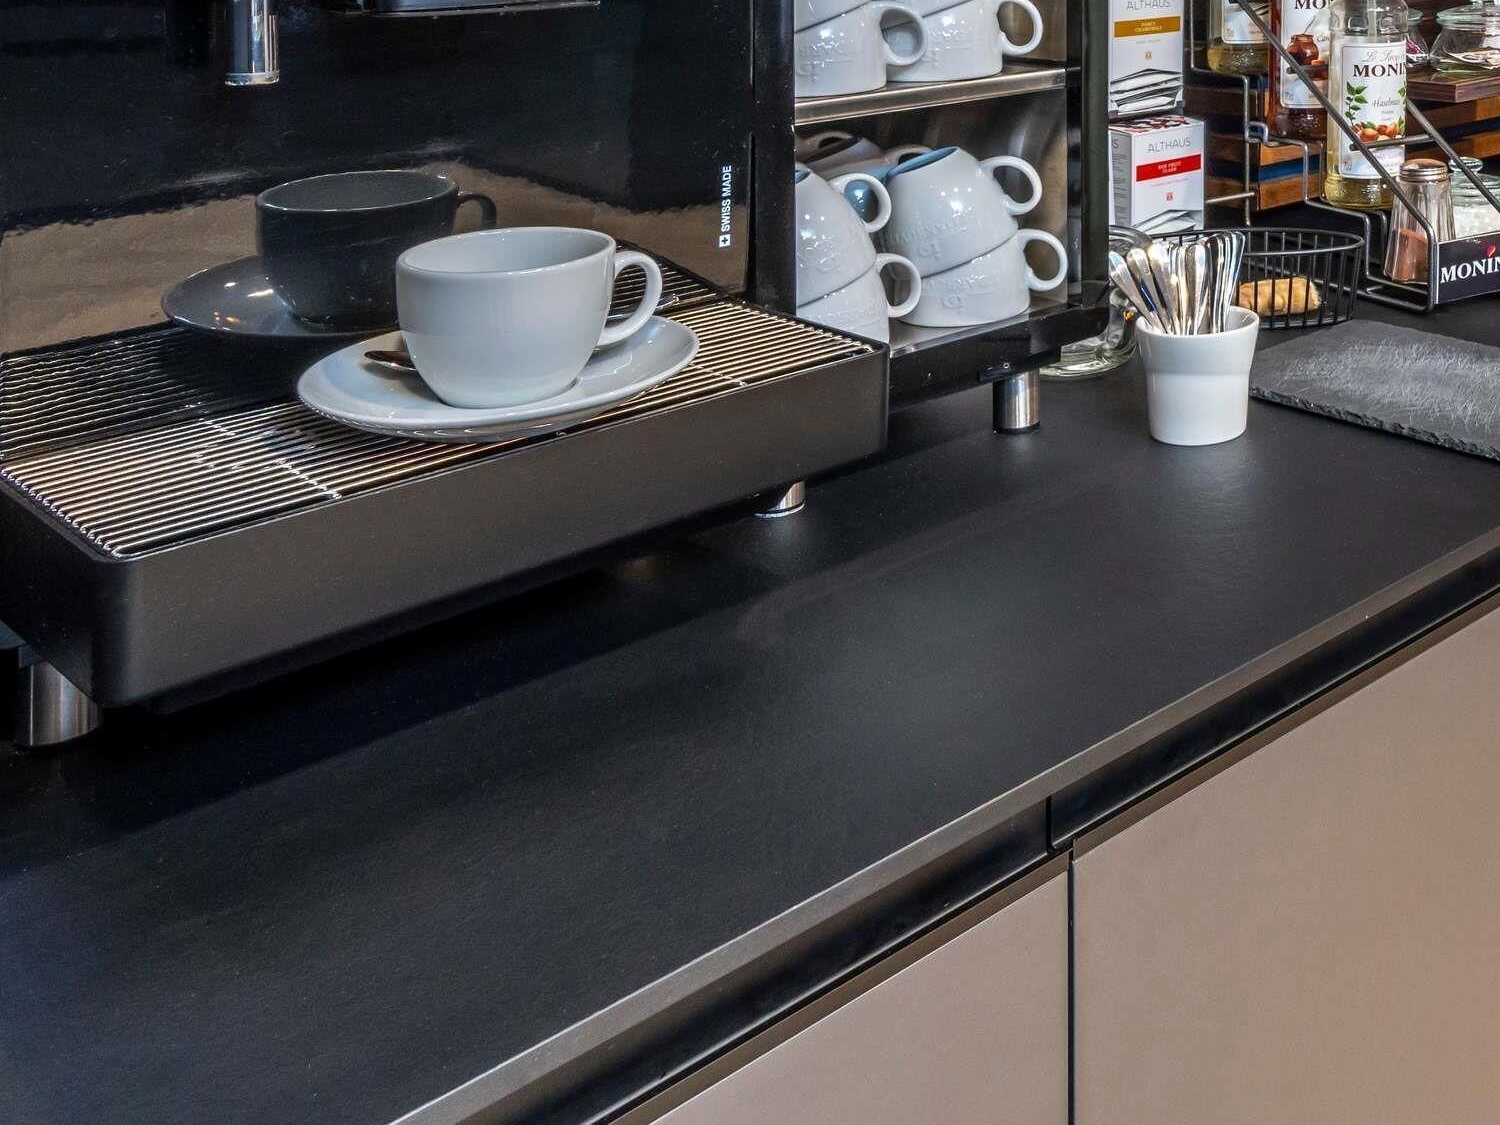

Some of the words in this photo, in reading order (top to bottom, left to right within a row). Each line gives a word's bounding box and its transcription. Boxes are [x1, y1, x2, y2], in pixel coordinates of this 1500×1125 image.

[1147, 137, 1192, 153] ALTHAUS
[721, 164, 732, 195] MADE
[721, 197, 731, 232] SWISS
